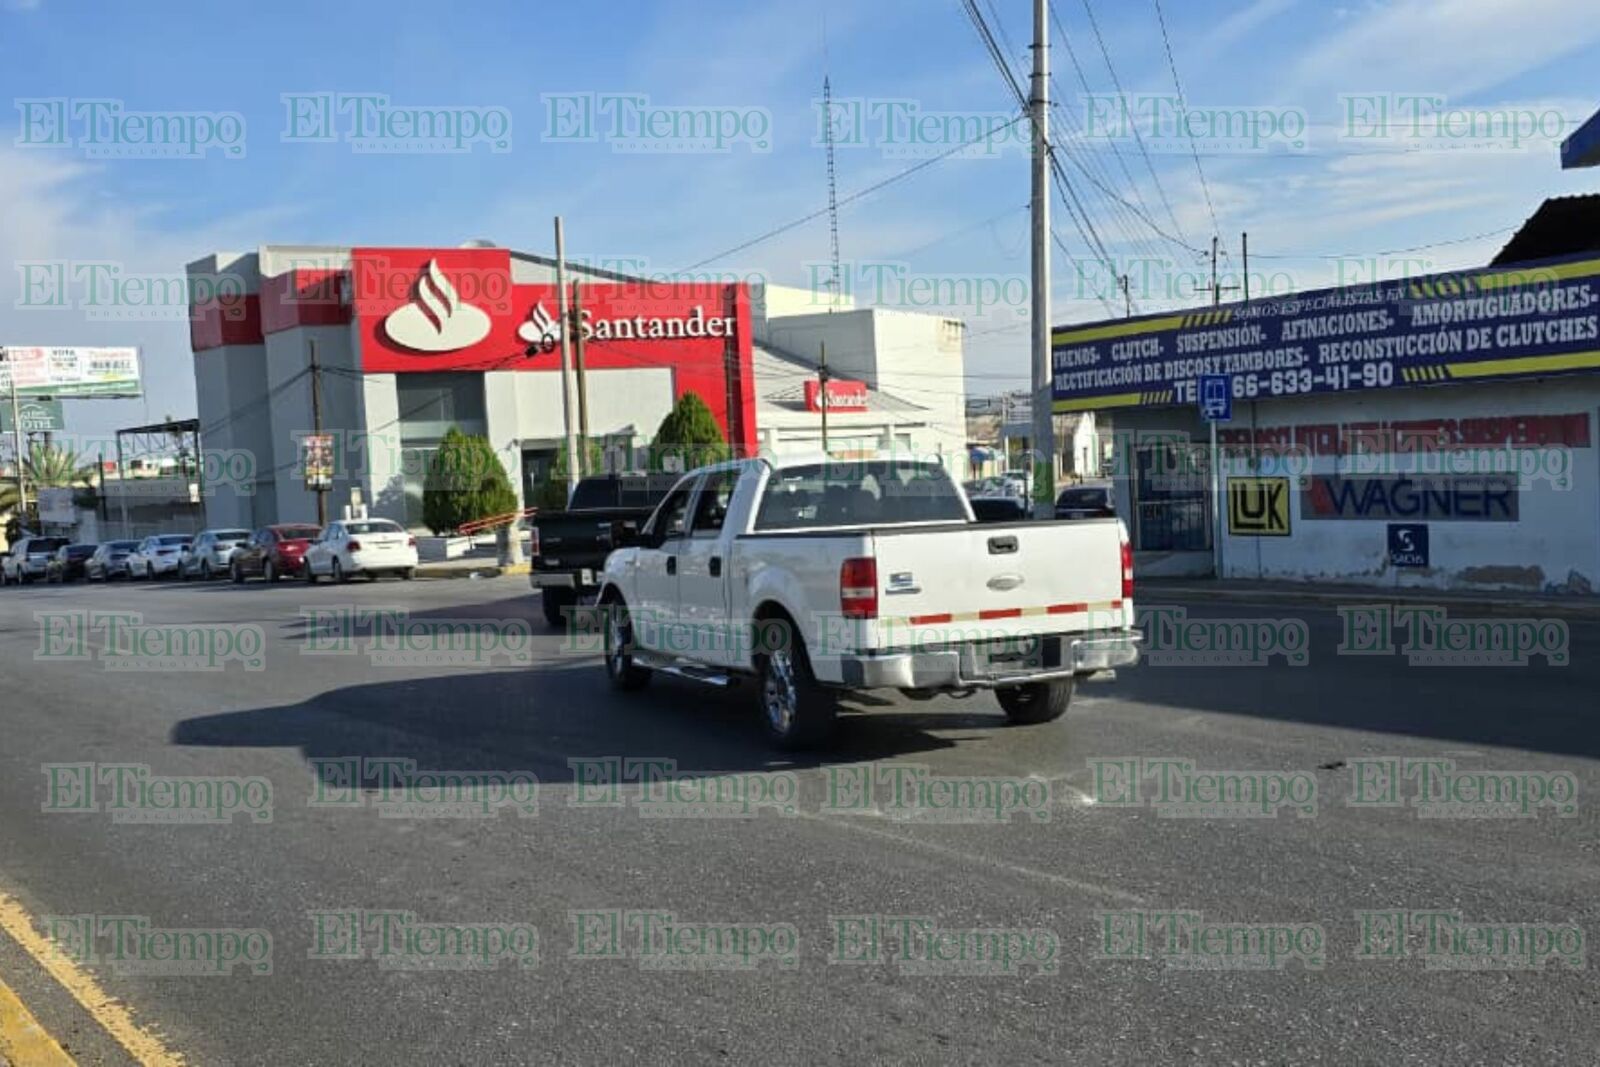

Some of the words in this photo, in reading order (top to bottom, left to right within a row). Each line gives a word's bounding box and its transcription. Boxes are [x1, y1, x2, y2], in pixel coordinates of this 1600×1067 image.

[580, 305, 736, 339] Santander
[1233, 303, 1278, 321] SOMOS
[1281, 289, 1383, 315] ESPECIALISTAS
[1054, 361, 1143, 391] RECTIFICACIÓN
[1144, 363, 1162, 382] DE
[1318, 323, 1463, 364] RECONSTUCCIÓN
[1466, 327, 1492, 351] DE
[1496, 315, 1599, 348] CLUTCHES
[1173, 380, 1197, 402] TE
[1232, 361, 1394, 398] 66-633-41-90
[1325, 477, 1512, 517] WAGNER
